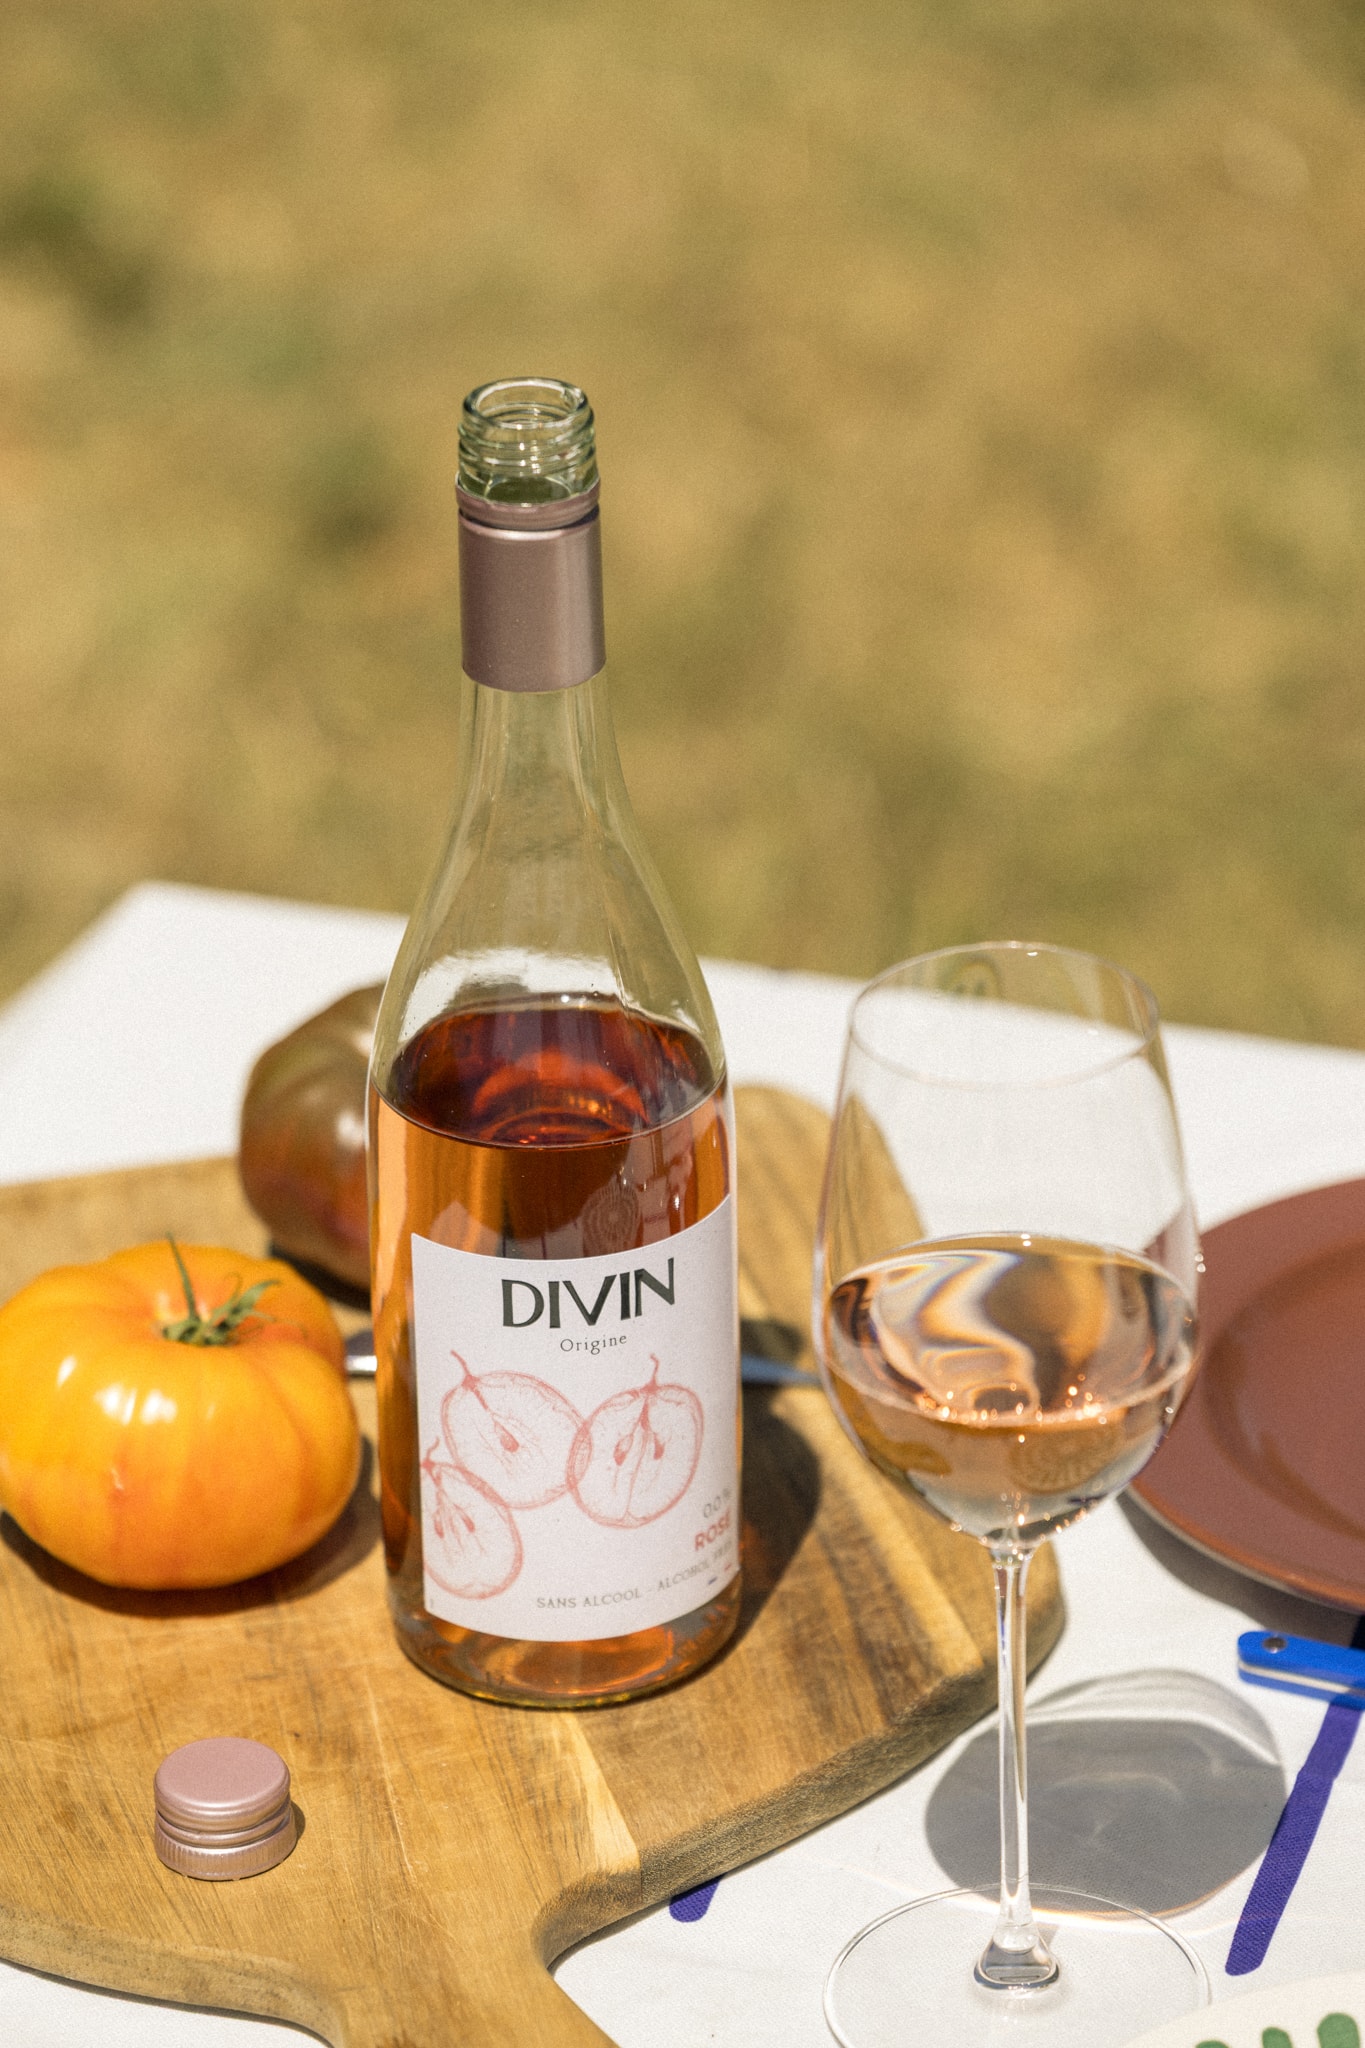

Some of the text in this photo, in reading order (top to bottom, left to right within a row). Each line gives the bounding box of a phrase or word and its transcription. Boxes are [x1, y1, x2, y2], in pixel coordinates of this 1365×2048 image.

[501, 1257, 675, 1329] DIVIN
[560, 1335, 627, 1355] Origine
[537, 1597, 577, 1609] SANS
[583, 1588, 640, 1607] ALCOOL
